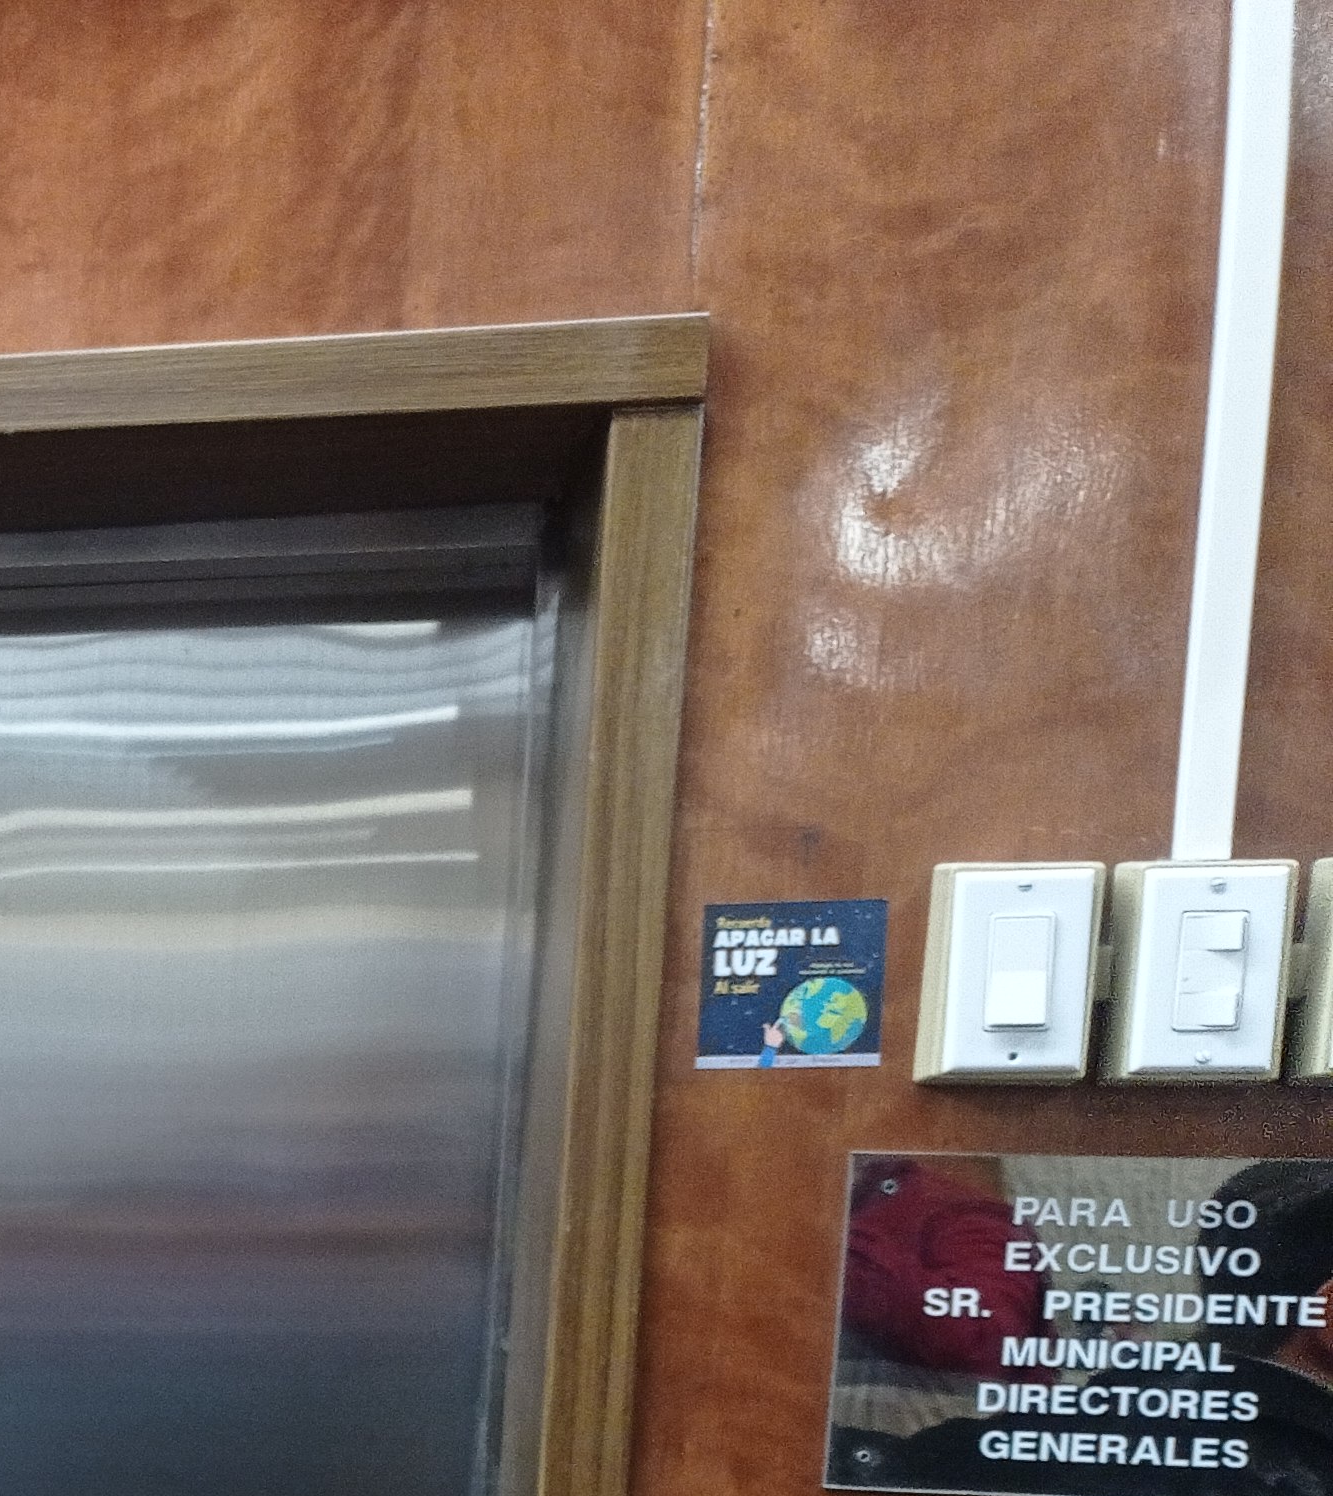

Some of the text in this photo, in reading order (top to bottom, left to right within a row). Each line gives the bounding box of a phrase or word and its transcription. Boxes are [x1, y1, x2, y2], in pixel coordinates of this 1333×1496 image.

[810, 926, 840, 946] LA
[713, 948, 778, 977] LUZ
[1012, 1197, 1257, 1230] PARA USO
[1004, 1241, 1261, 1277] EXCLUSIVO
[922, 1287, 1327, 1328] SR. PRESIDENTE
[1001, 1336, 1235, 1373] MUNICIPAL
[977, 1382, 1259, 1422] DIRECTORES
[979, 1430, 1249, 1469] GENERALES
